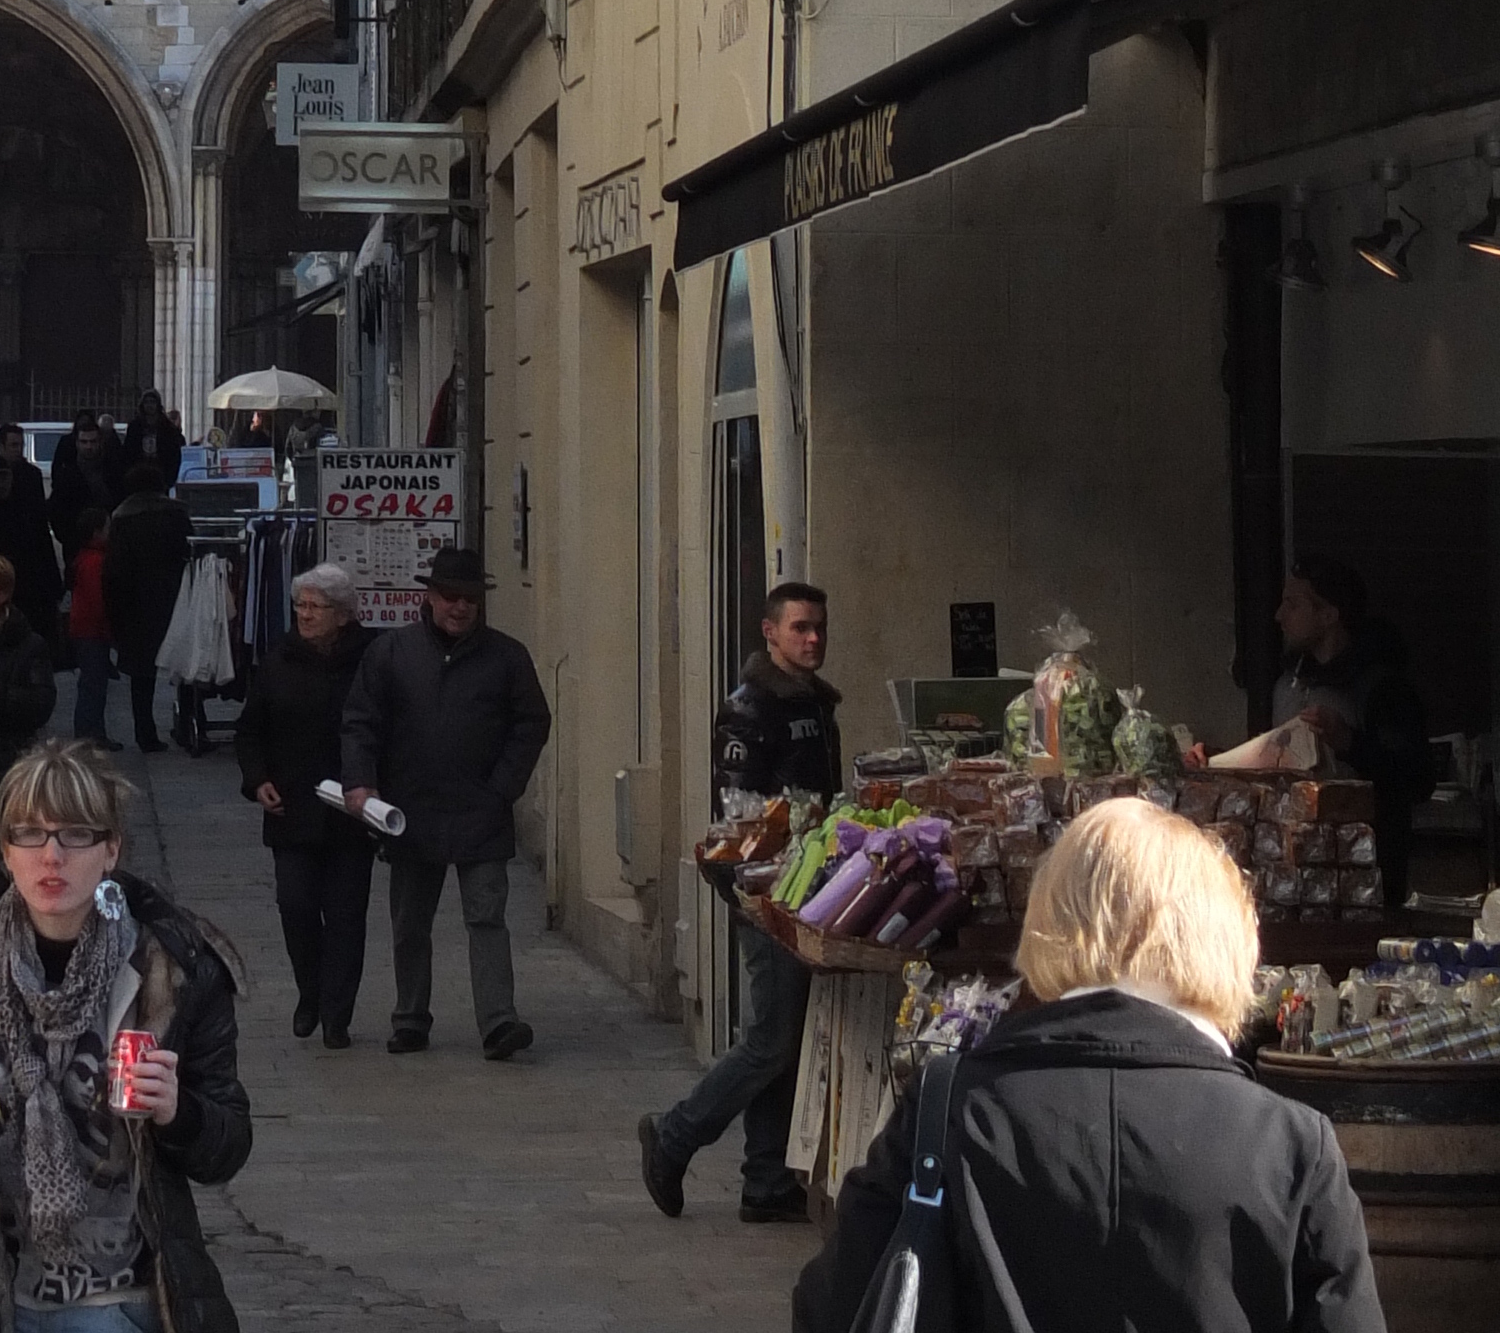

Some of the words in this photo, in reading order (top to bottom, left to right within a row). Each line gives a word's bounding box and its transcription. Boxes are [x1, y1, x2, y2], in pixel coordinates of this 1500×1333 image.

[291, 72, 335, 95] Jean
[293, 95, 344, 116] Louis
[309, 149, 442, 186] OSCAR
[828, 126, 846, 203] DE
[322, 454, 456, 470] RESTAURANT
[340, 475, 441, 491] JAPONAIS
[326, 493, 455, 518] OSAKA
